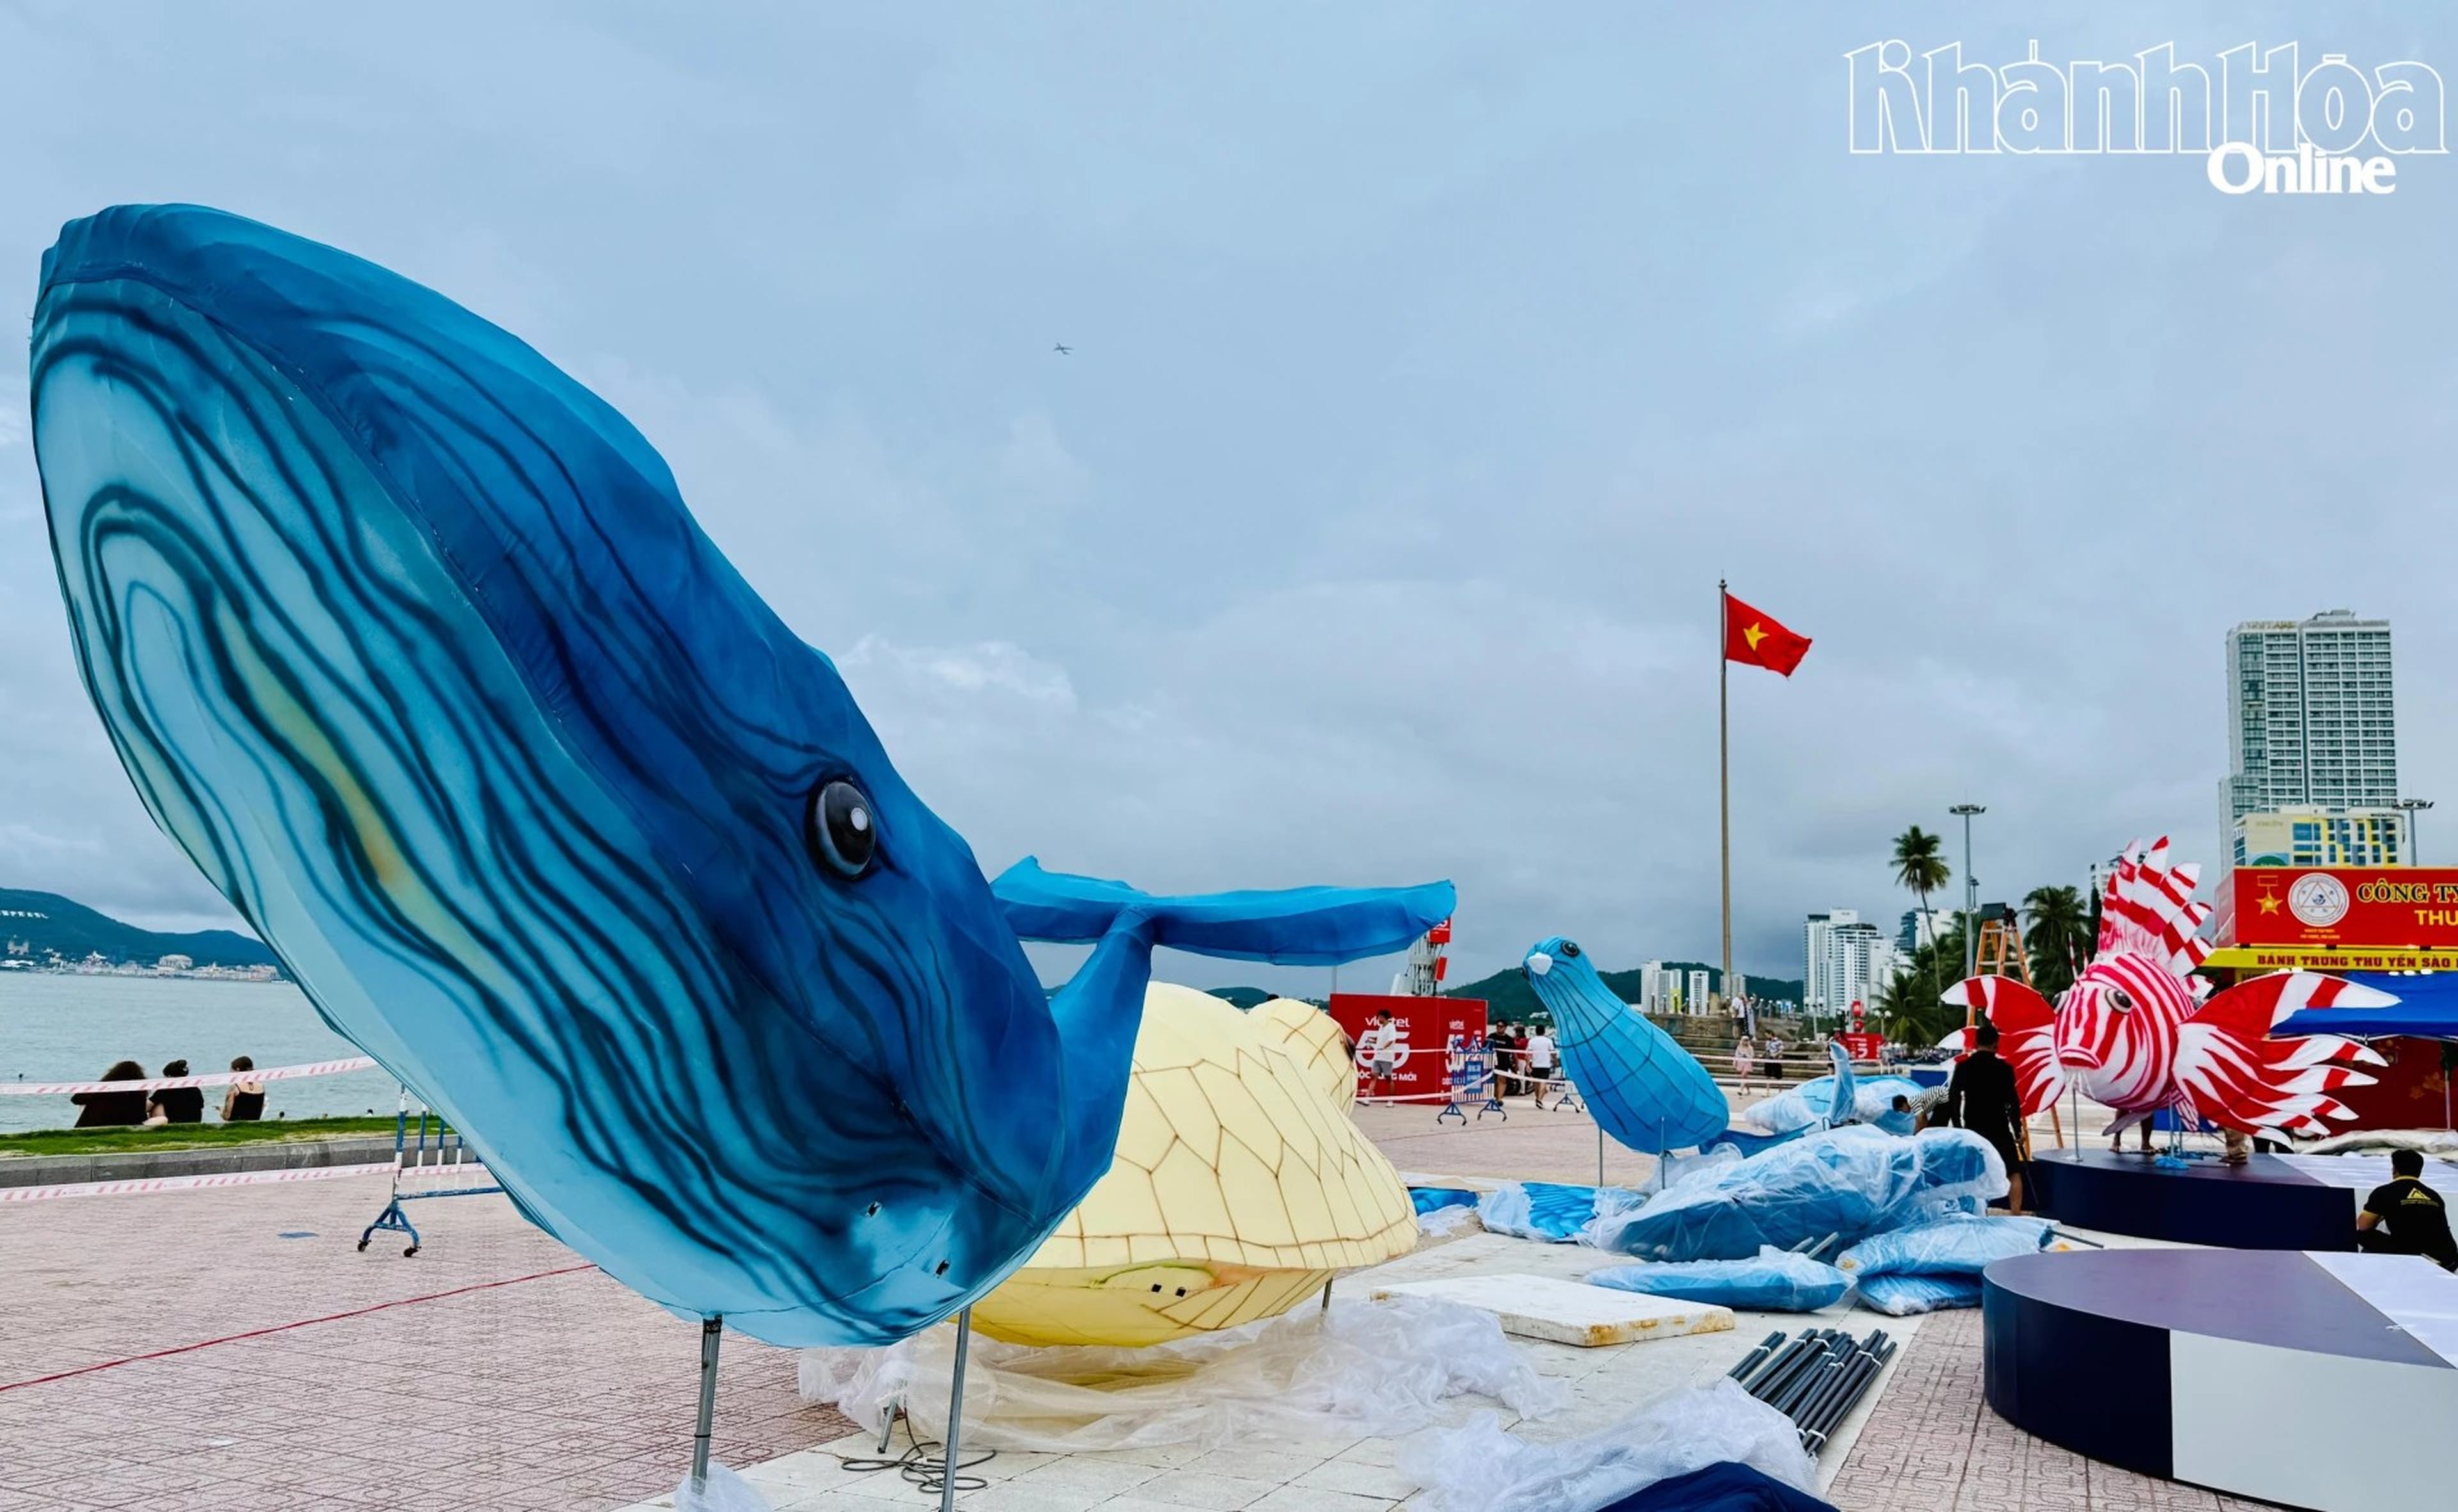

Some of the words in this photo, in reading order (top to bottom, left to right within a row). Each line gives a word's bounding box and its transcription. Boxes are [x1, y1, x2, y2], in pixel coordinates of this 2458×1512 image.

[2357, 878, 2430, 903] CÔNG
[2257, 953, 2295, 965] BÁNH
[2301, 956, 2349, 966] TRUNG
[2353, 957, 2382, 967] THU
[2422, 954, 2450, 968] SÀO
